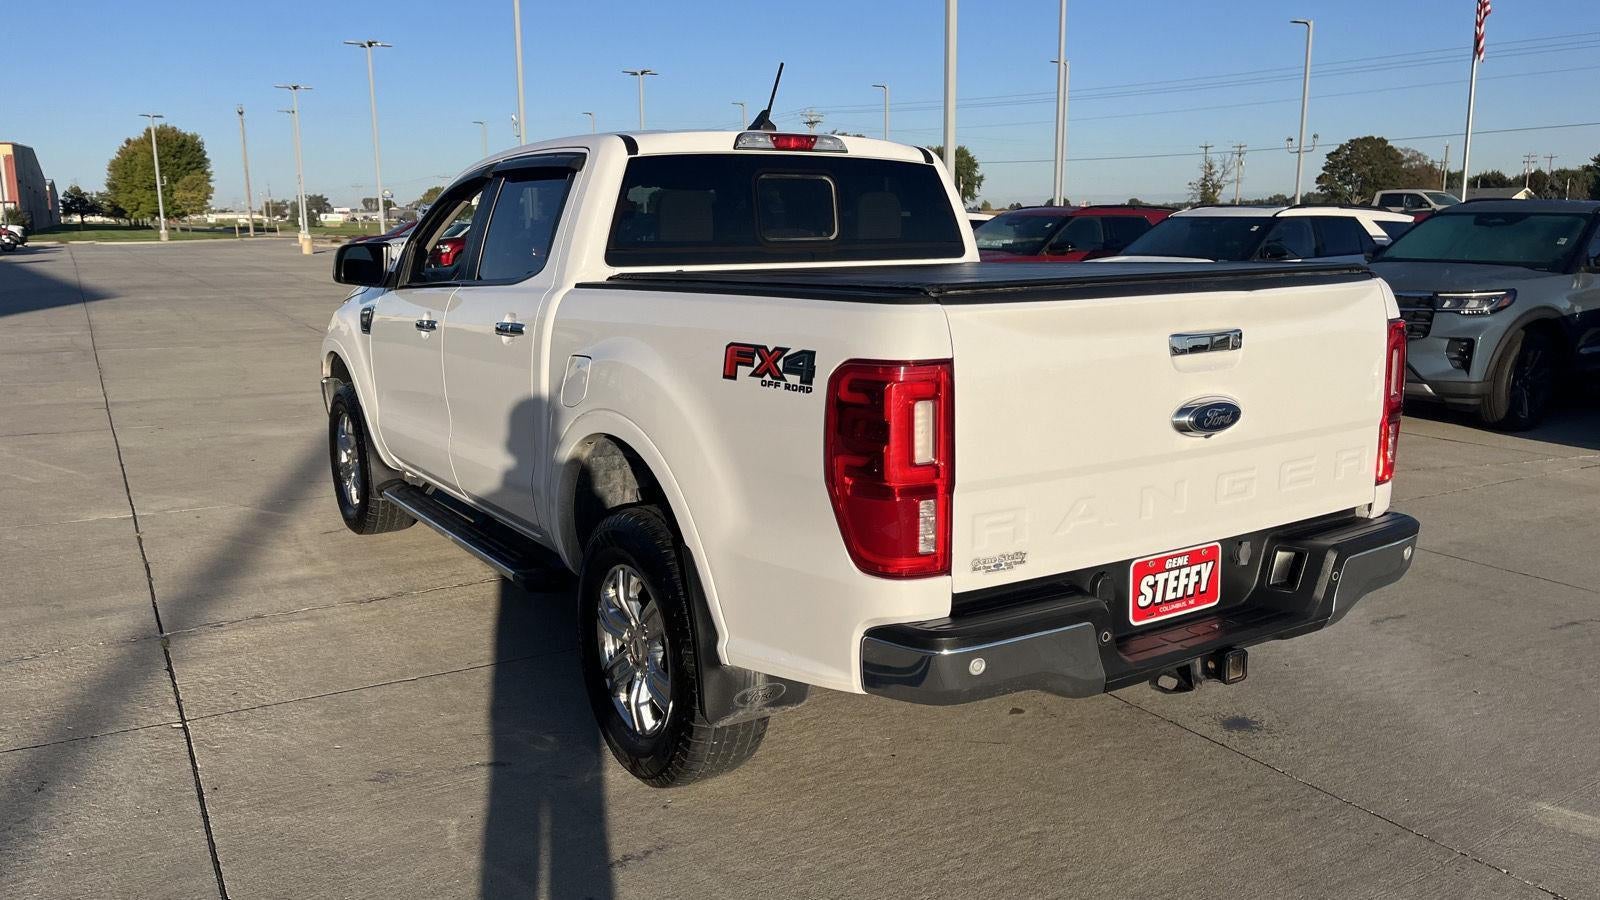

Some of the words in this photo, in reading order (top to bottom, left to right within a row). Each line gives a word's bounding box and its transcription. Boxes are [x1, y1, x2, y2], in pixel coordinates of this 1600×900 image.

[722, 342, 816, 386] FX4
[761, 380, 781, 389] OFF
[784, 383, 813, 394] ROAD
[1204, 408, 1233, 427] Ford
[971, 444, 1369, 550] RANGER
[1165, 555, 1190, 569] GENE
[1137, 560, 1215, 608] STEFFY
